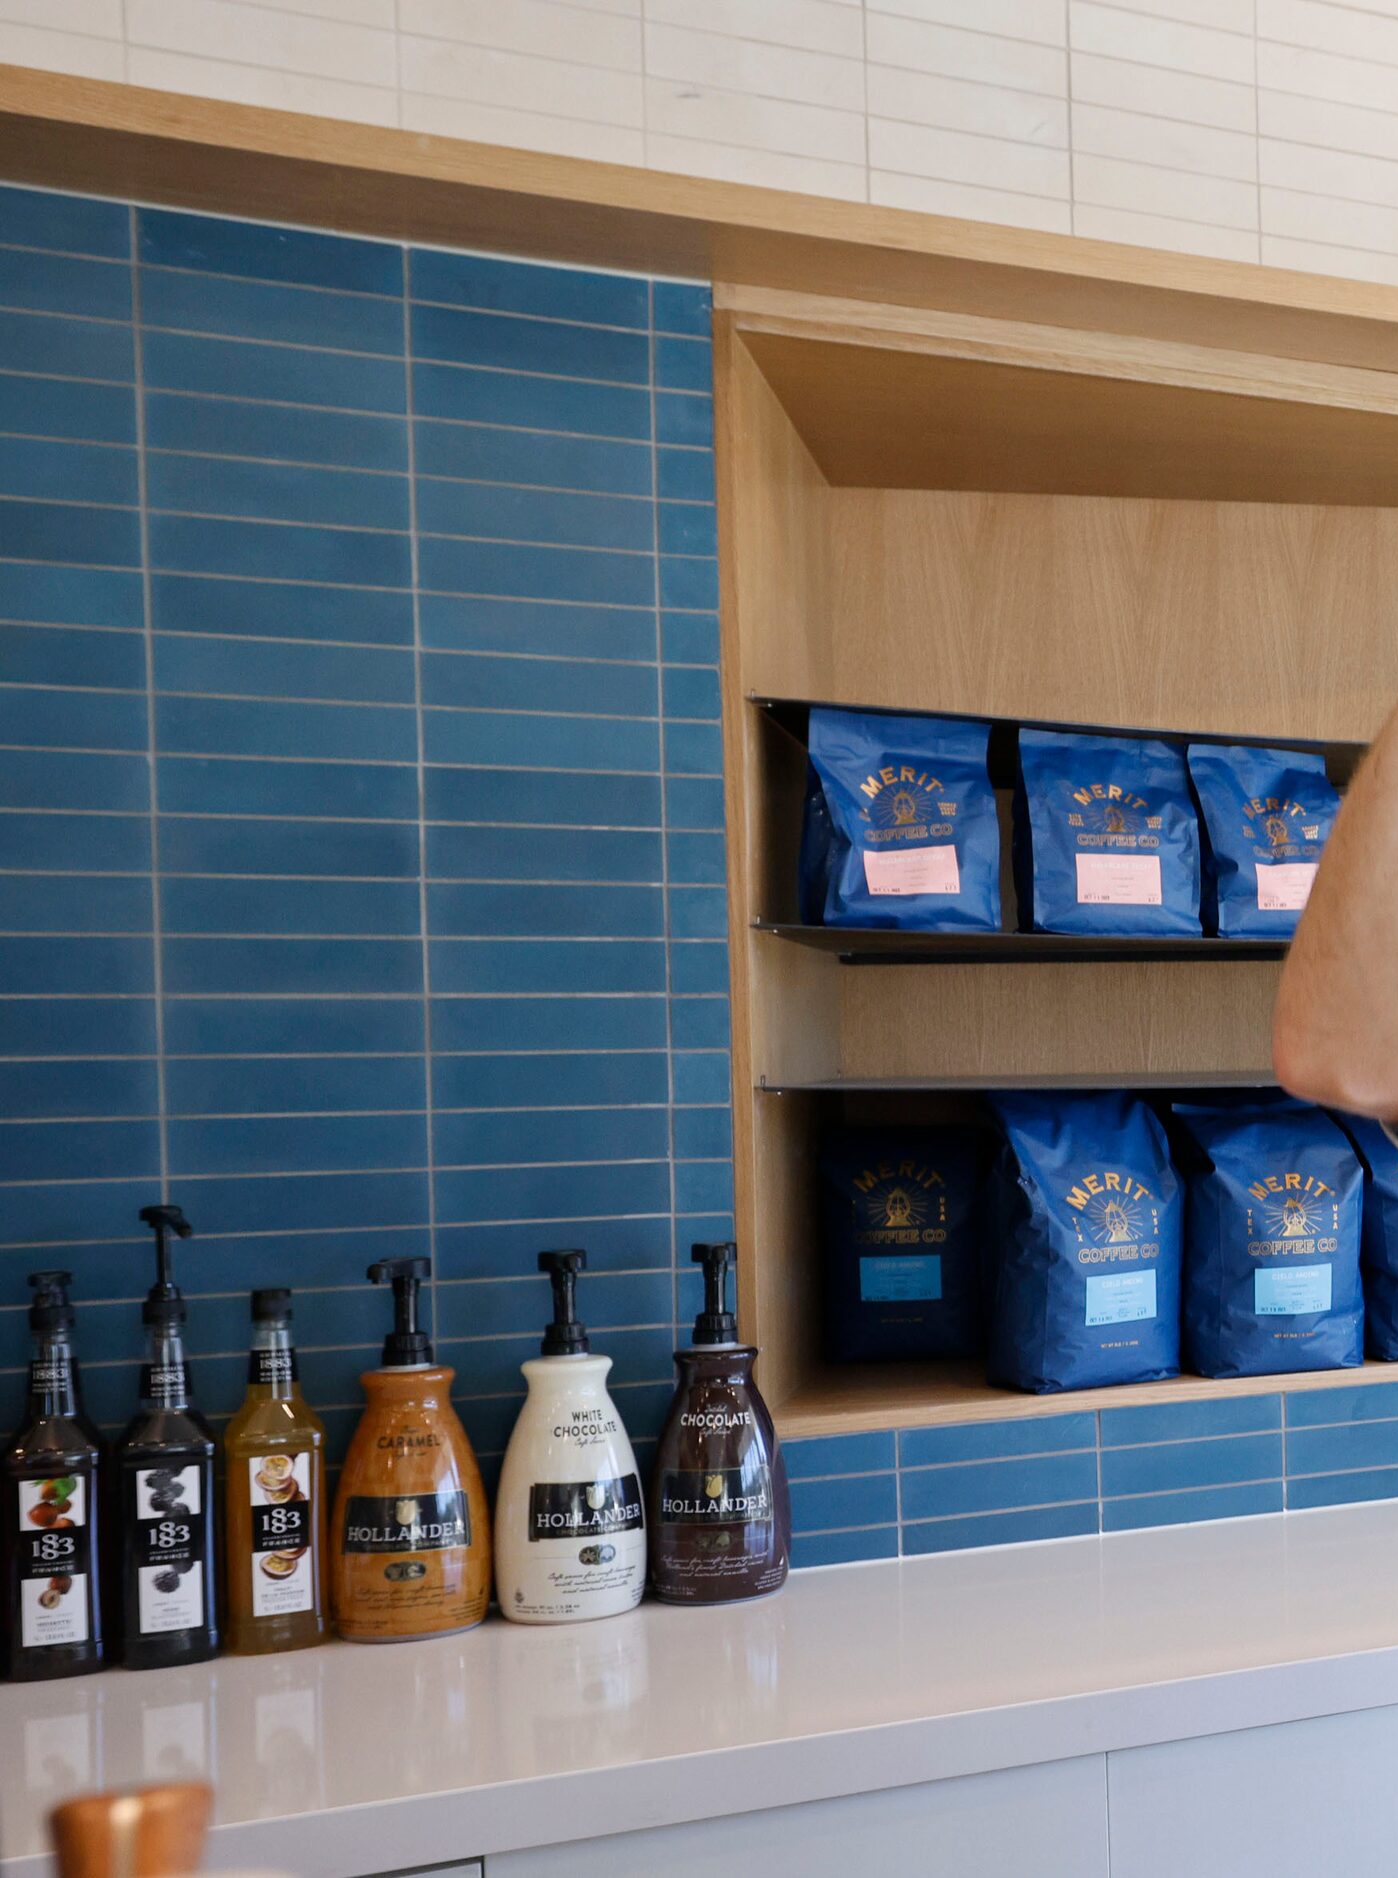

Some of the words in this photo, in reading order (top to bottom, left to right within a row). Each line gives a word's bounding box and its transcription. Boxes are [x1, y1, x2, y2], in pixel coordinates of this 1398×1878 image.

[860, 766, 943, 798] MERIT
[1073, 784, 1148, 806] MERIT
[1242, 799, 1304, 819] MERIT
[864, 825, 928, 842] COFFEE
[930, 823, 953, 836] CO
[1077, 834, 1137, 847] COFFEE
[1138, 835, 1160, 848] CO
[853, 1160, 944, 1193] MERIT
[1248, 1173, 1329, 1201] MERIT
[1066, 1172, 1149, 1211] MERIT
[1151, 1208, 1159, 1235] USA
[855, 1229, 920, 1244] COFFEE
[922, 1229, 948, 1243] CO
[1248, 1239, 1316, 1255] COFFEE
[1317, 1238, 1338, 1252] CO
[1078, 1245, 1139, 1264] COFFEE
[1141, 1243, 1160, 1258] CO
[260, 1359, 292, 1369] 1883
[572, 1409, 603, 1423] WHITE
[680, 1411, 751, 1427] CHOCOLATE
[554, 1421, 617, 1438] CHOCOLATE
[377, 1434, 440, 1449] CARAMEL
[662, 1494, 768, 1514] HOLLANDER
[262, 1508, 301, 1534] 1883
[537, 1502, 640, 1528] HOLLANDER
[150, 1521, 191, 1548] 1883
[347, 1521, 465, 1542] HOLLANDER
[32, 1534, 75, 1561] 1883
